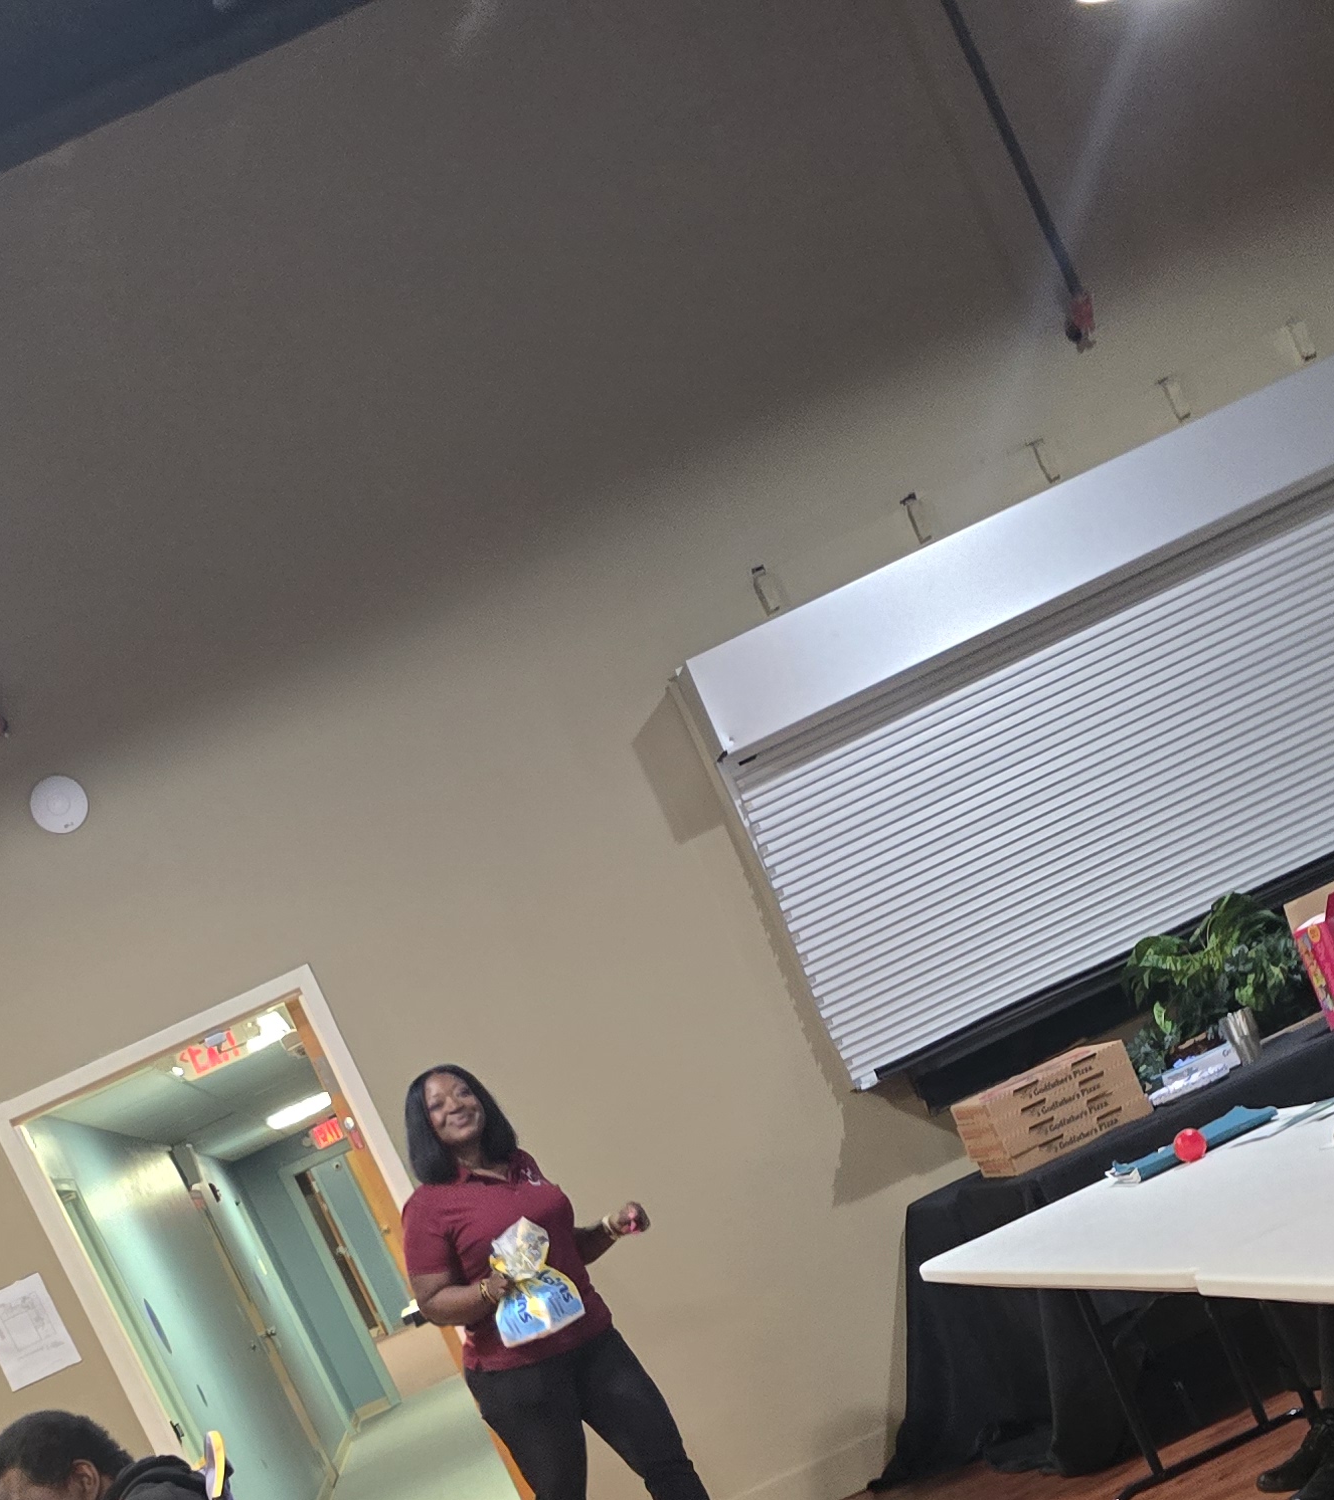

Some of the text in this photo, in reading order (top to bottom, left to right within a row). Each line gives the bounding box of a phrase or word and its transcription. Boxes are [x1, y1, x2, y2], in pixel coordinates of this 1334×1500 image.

[1072, 1065, 1093, 1079] Pizza
[1080, 1083, 1101, 1097] Pizza
[1087, 1101, 1109, 1115] Pizza
[1098, 1118, 1119, 1132] Pizza
